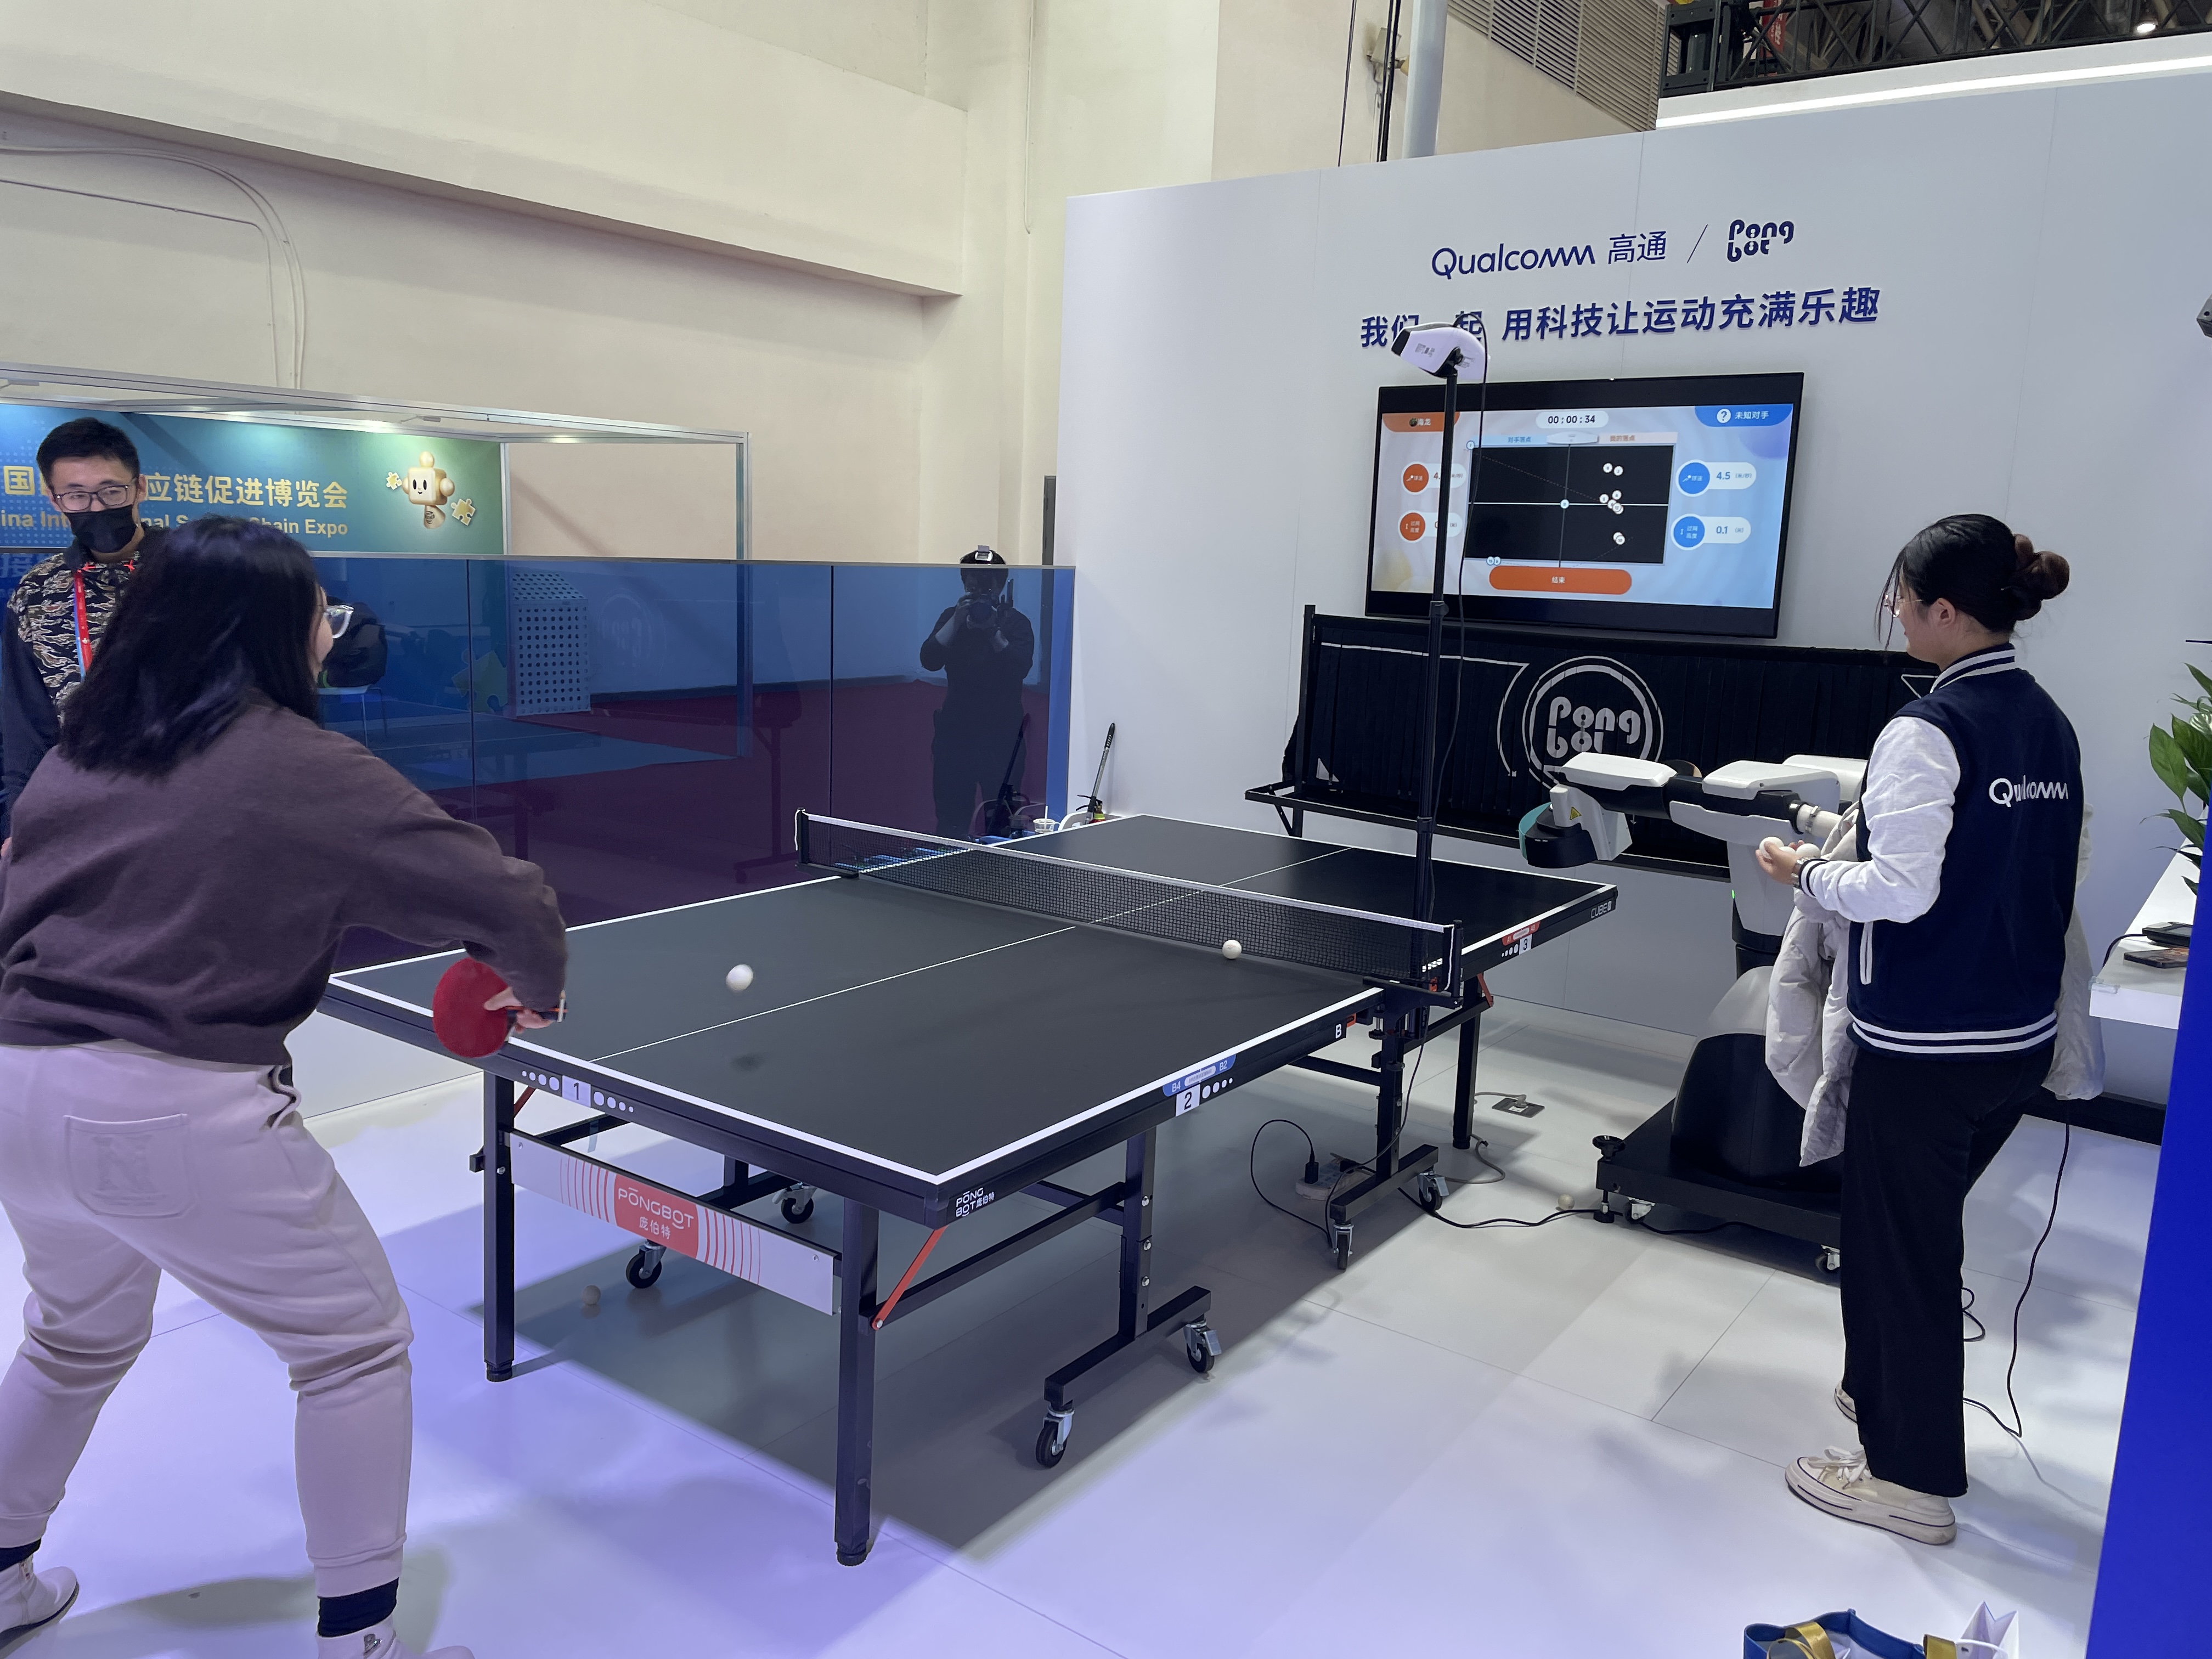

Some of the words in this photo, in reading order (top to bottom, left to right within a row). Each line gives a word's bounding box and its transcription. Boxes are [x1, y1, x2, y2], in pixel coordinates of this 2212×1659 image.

[1728, 219, 1795, 244] Pong
[1432, 243, 1596, 280] Qualcomm
[1607, 230, 1667, 264] 高通
[1361, 311, 1482, 348] 我们起
[1502, 286, 1881, 342] 用科技让运动充满乐趣
[1734, 411, 1769, 420] 未知对手
[1716, 471, 1730, 480] 4.5
[1, 510, 33, 527] ina
[305, 518, 348, 538] Expo
[1716, 526, 1728, 534] 0.1
[1548, 696, 1641, 744] Pong
[1989, 775, 2069, 808] Qulcomm
[1523, 938, 1528, 951] 3
[1335, 1024, 1342, 1039] B
[1172, 1081, 1181, 1092] B4
[1219, 1060, 1228, 1071] B2
[573, 1082, 579, 1101] 1
[1184, 1091, 1192, 1110] 2
[639, 1216, 671, 1240] 庞伯特
